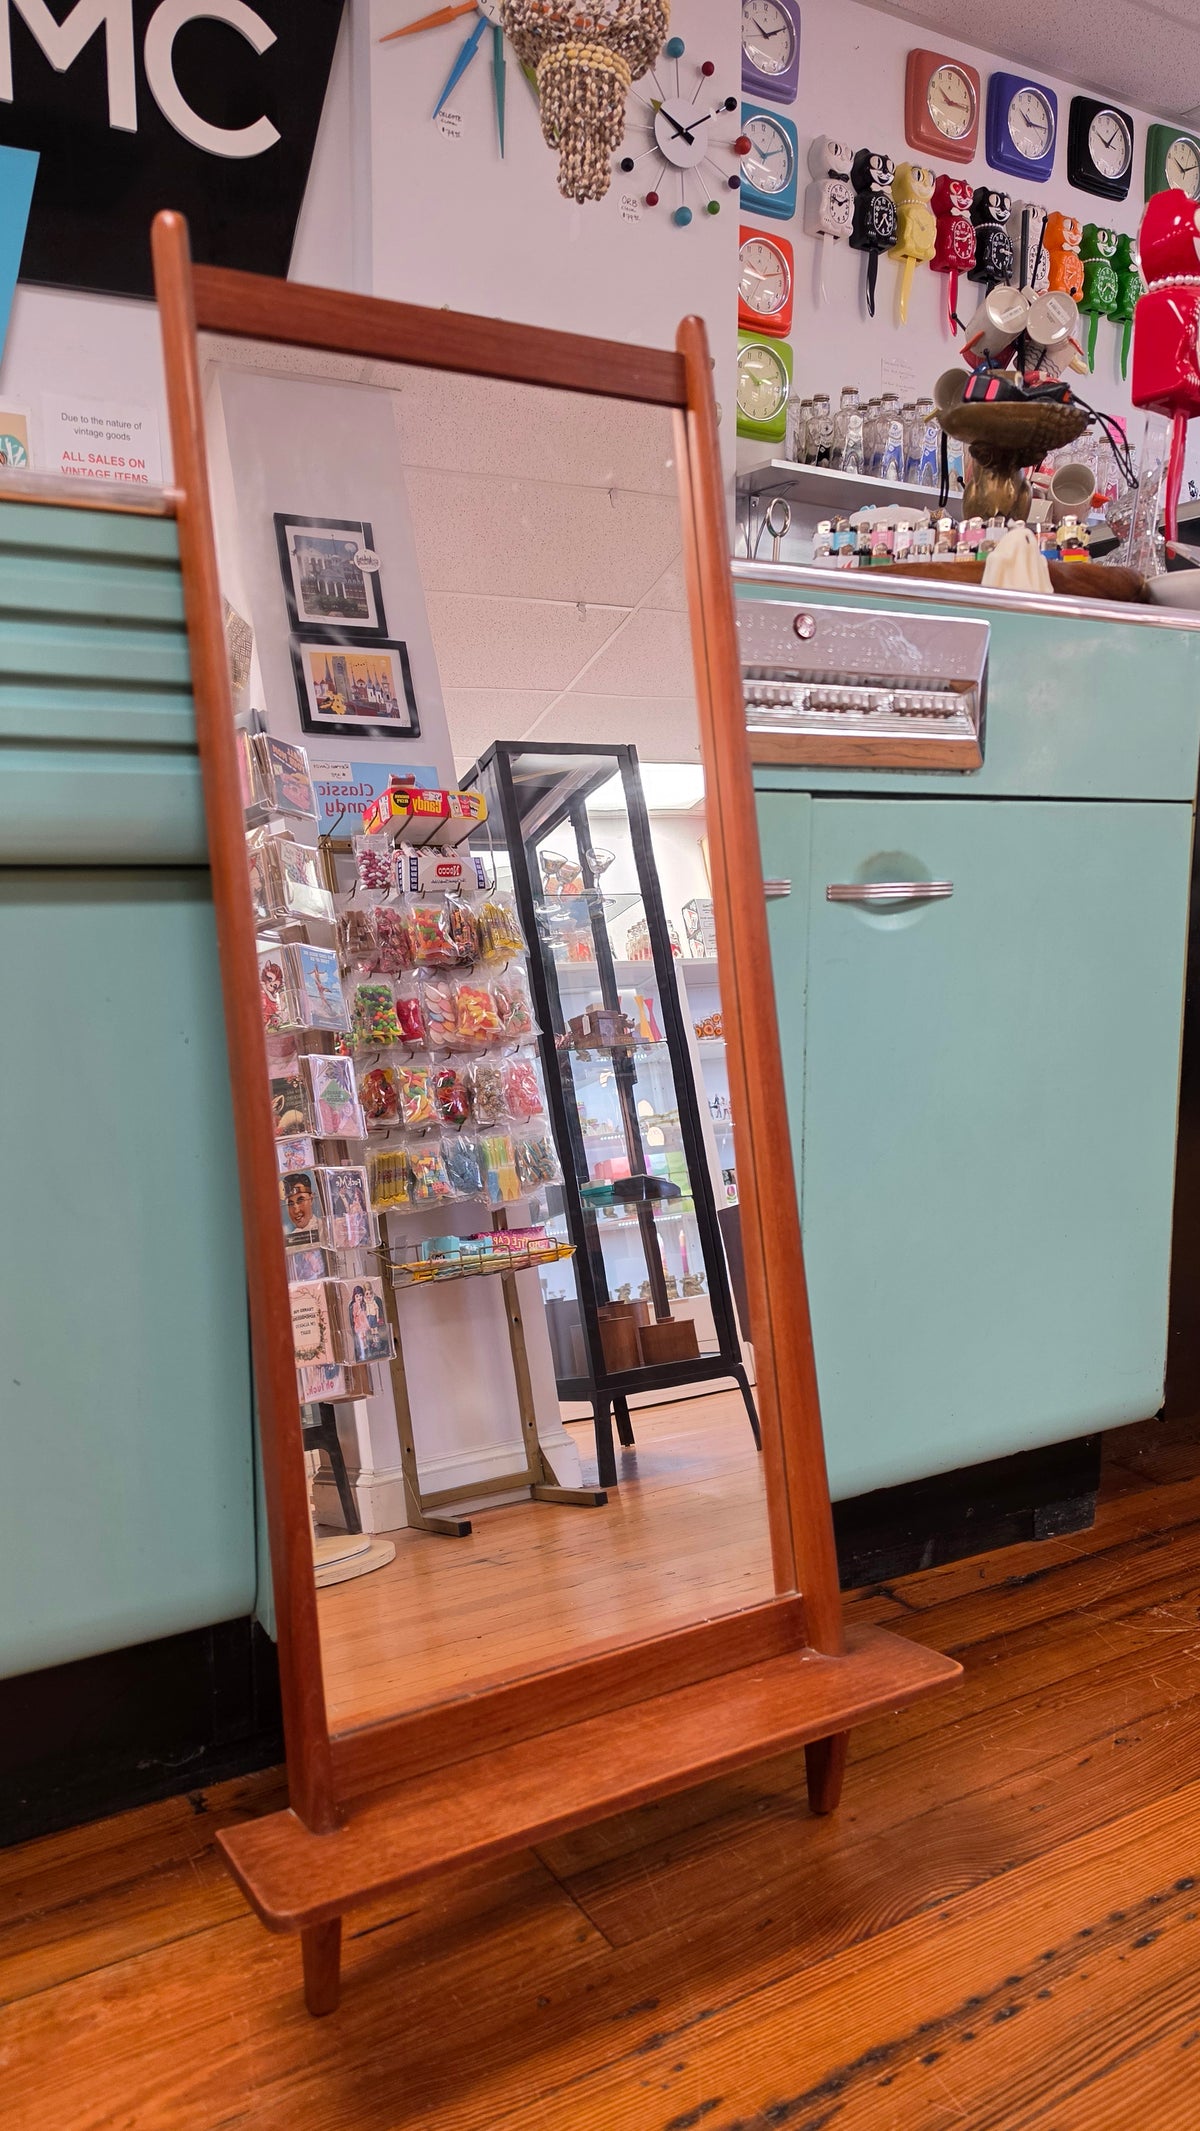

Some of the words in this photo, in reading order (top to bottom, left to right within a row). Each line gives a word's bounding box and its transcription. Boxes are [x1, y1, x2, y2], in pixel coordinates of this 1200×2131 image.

[489, 5, 495, 16] 7
[61, 412, 79, 422] Due
[80, 416, 89, 424] to
[91, 416, 104, 426] the
[106, 419, 132, 429] nature
[134, 422, 142, 430] of
[73, 428, 104, 439] vintage
[105, 432, 131, 441] goods
[62, 451, 85, 462] ALL
[88, 453, 125, 467] SALES
[128, 458, 145, 469] ON
[61, 466, 111, 478] VINTAGE
[114, 472, 149, 484] ITEMS
